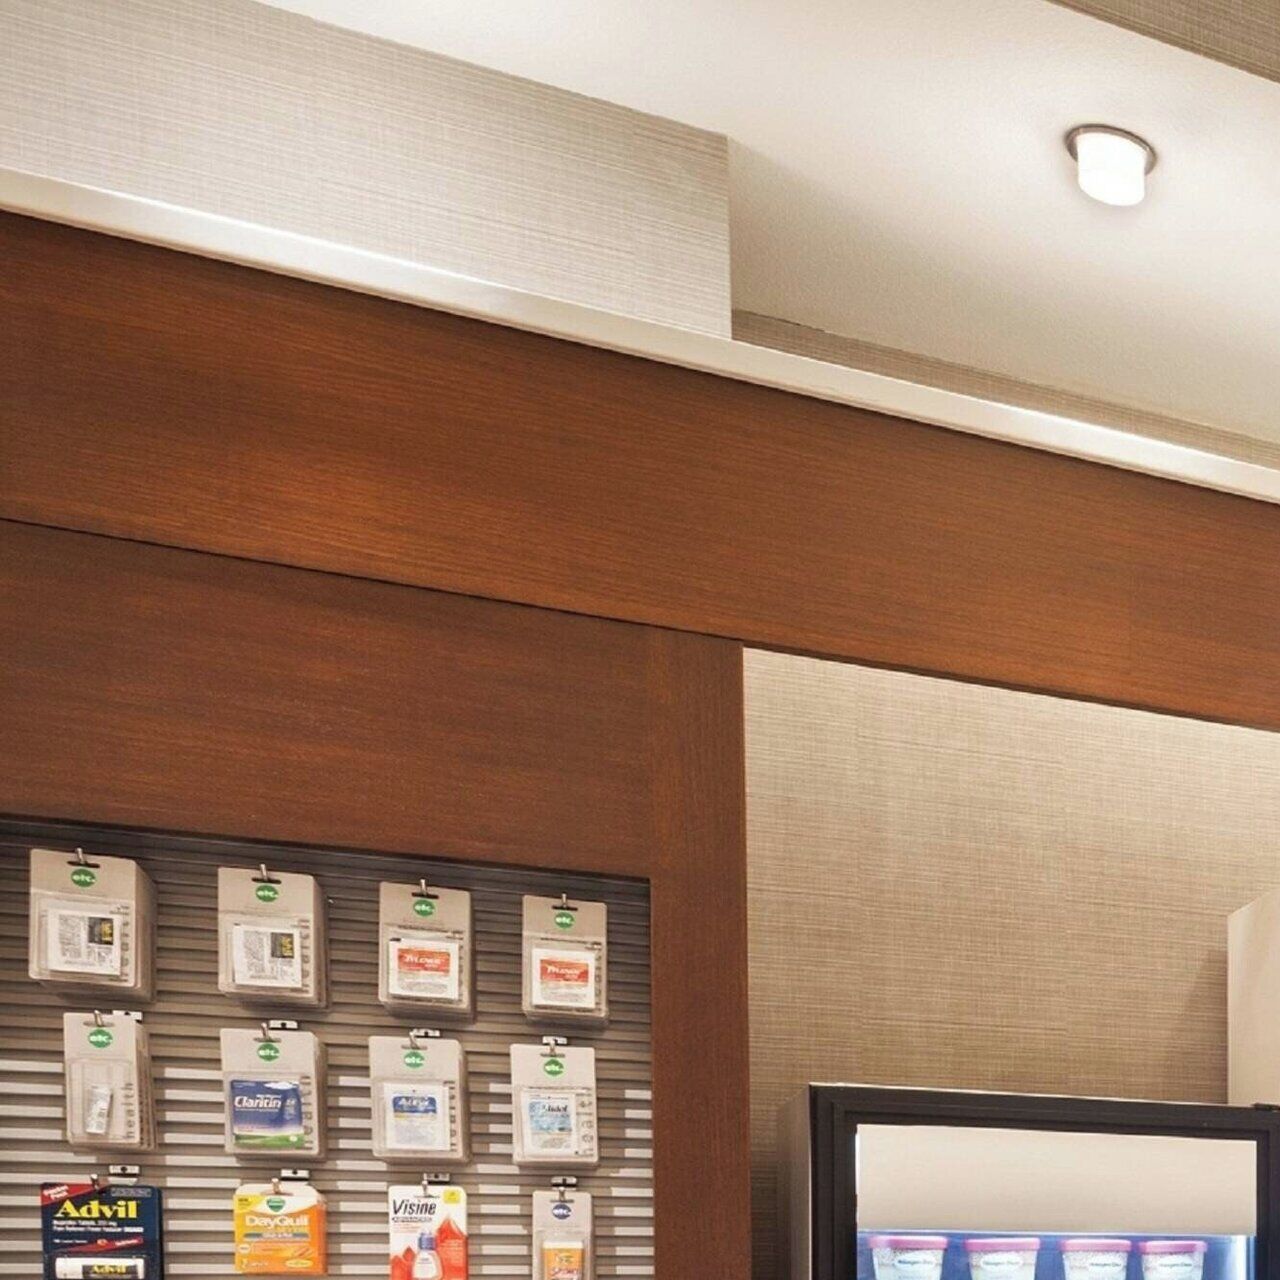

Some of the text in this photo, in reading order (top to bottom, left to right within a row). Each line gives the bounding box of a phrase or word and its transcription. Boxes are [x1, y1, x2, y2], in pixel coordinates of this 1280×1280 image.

[235, 1095, 282, 1109] Claritin
[53, 1200, 139, 1218] Advil
[392, 1200, 436, 1216] Visine
[90, 1264, 126, 1274] Advil
